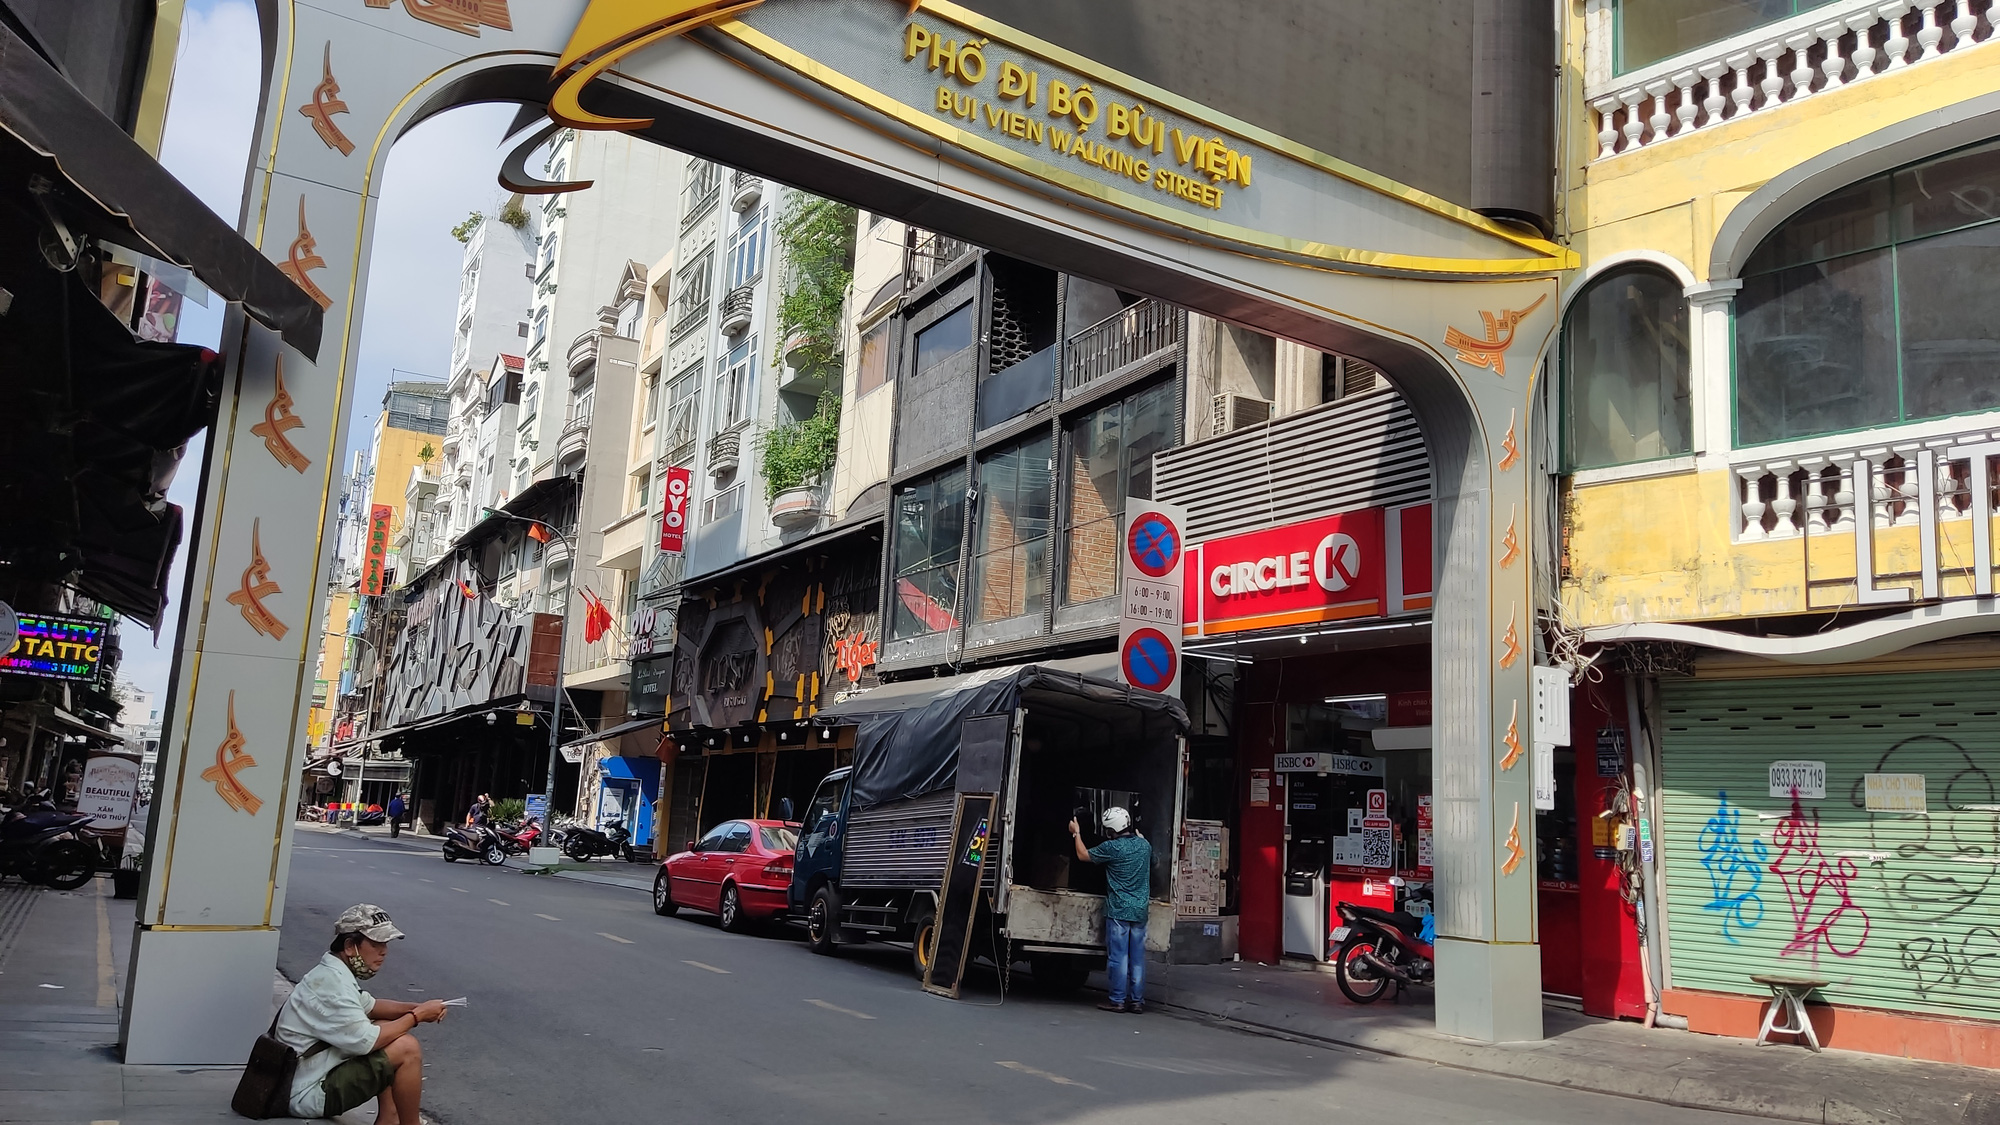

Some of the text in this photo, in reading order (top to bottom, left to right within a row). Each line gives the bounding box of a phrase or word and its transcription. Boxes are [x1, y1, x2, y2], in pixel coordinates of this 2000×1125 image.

[905, 22, 1252, 189] PHỐ ĐI BỘ BÙI VIỆN
[936, 86, 1224, 210] BUI VIEN WALKING STREET
[666, 479, 686, 528] OYO
[1210, 551, 1309, 596] CIRCLE
[1135, 586, 1149, 598] 6:00
[1156, 589, 1170, 601] 9:00
[1129, 603, 1147, 616] 16:00
[1155, 607, 1172, 619] 19:00
[18, 618, 99, 643] EAUTY
[836, 631, 877, 681] Tiger
[643, 682, 658, 694] HOTEL
[1277, 757, 1301, 768] HSBC
[1332, 758, 1358, 771] HSBC
[1771, 768, 1823, 788] 0933.837.119
[1886, 777, 1900, 790] CHO
[86, 787, 131, 797] BEAUTIFUL
